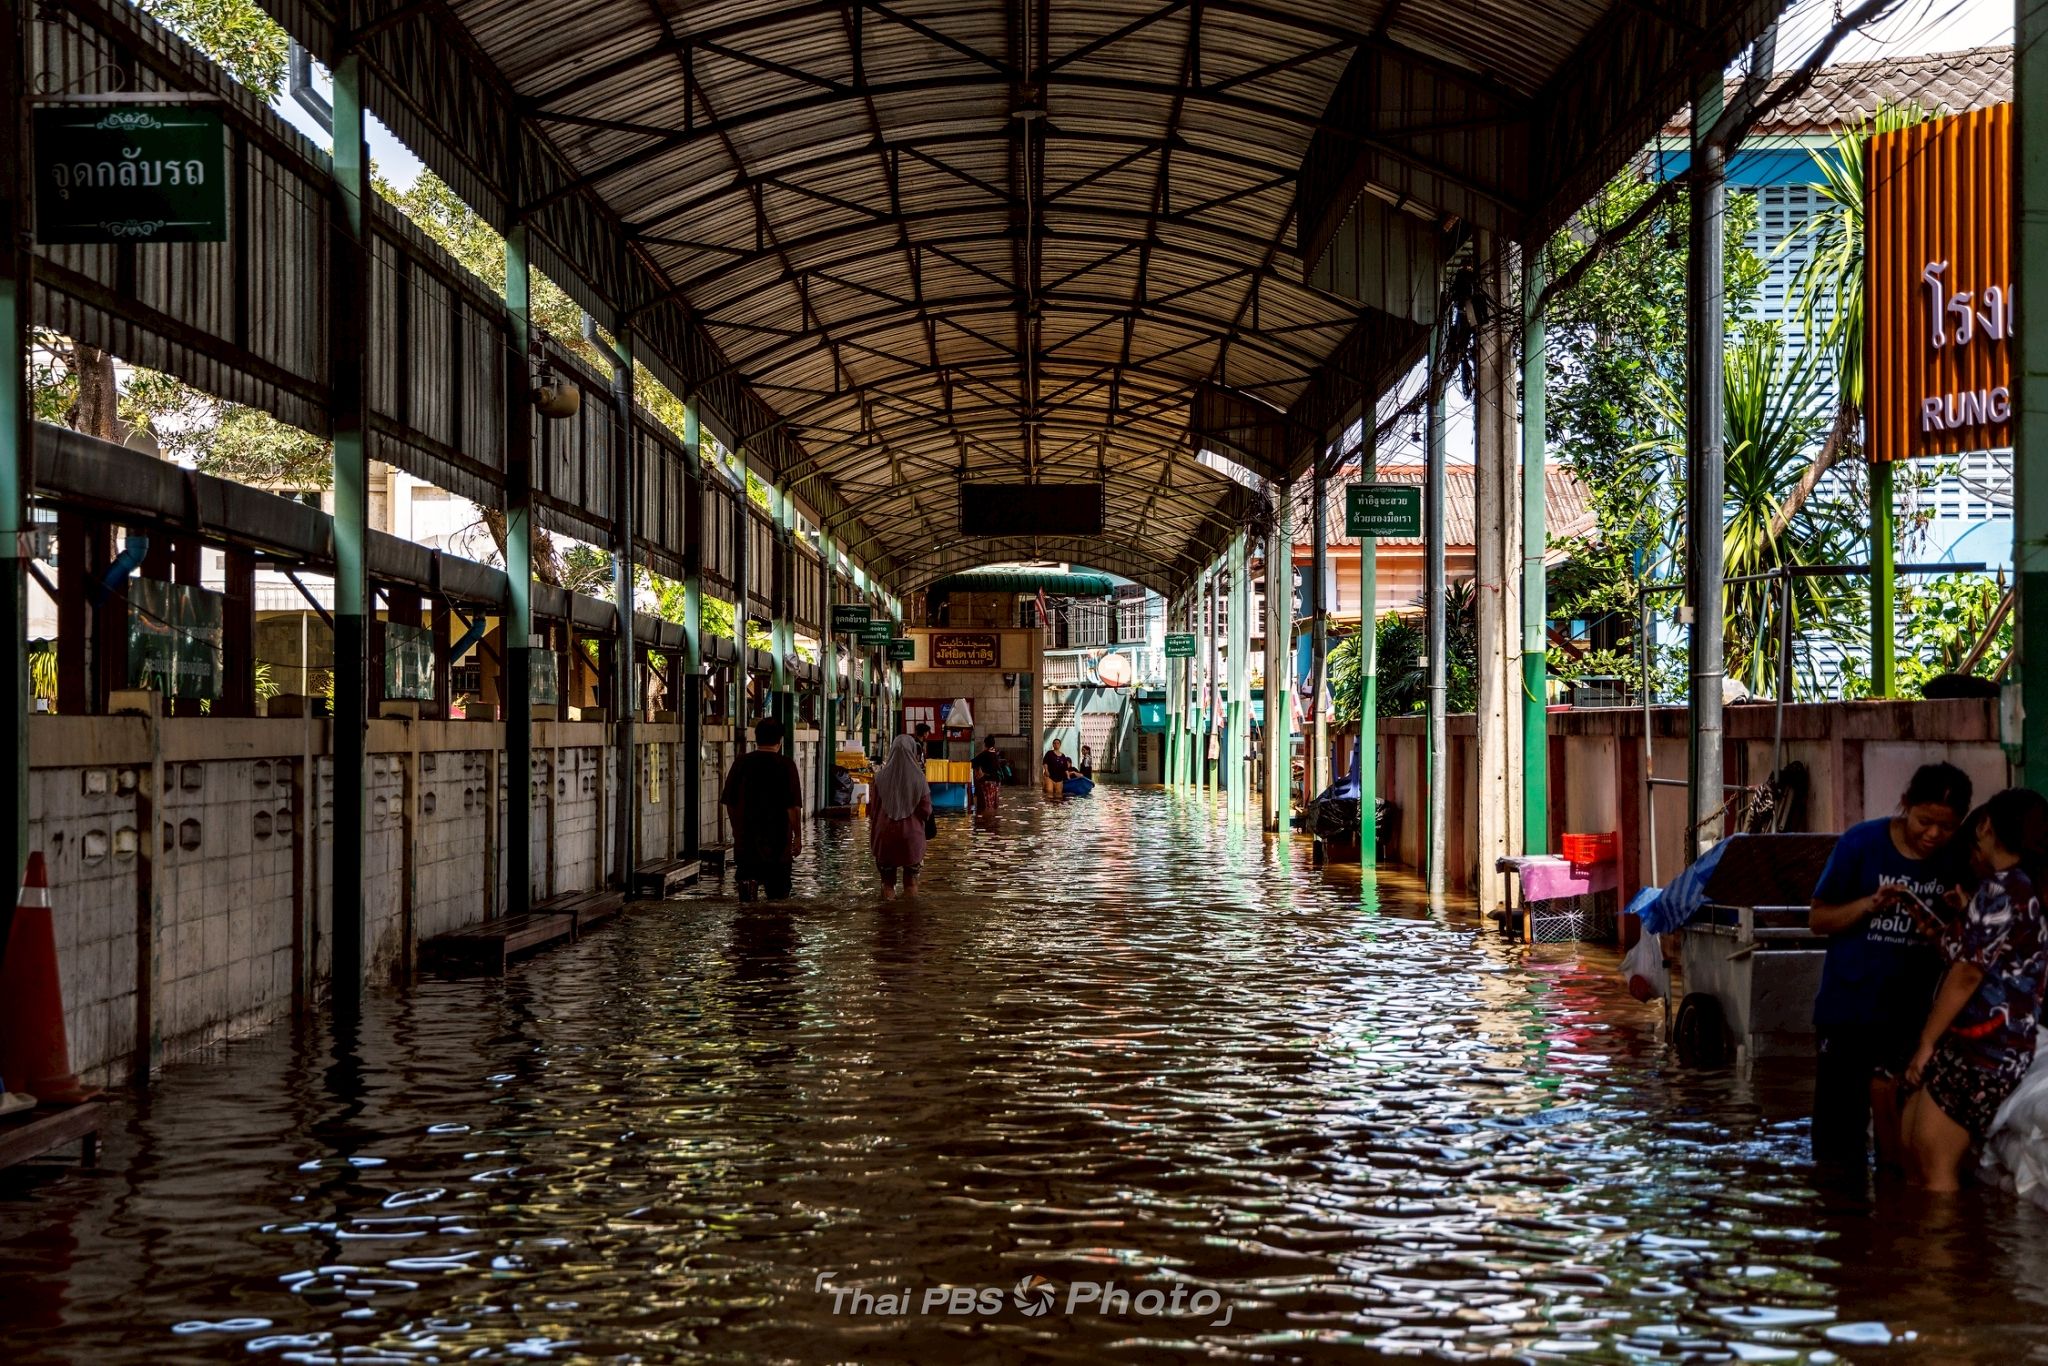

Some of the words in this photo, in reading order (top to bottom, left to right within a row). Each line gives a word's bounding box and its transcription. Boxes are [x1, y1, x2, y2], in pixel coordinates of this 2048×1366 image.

[52, 147, 205, 200] จุดกลับรถ
[1922, 386, 2012, 432] RUNG
[1353, 511, 1412, 523] ด้วยสองมือเรา
